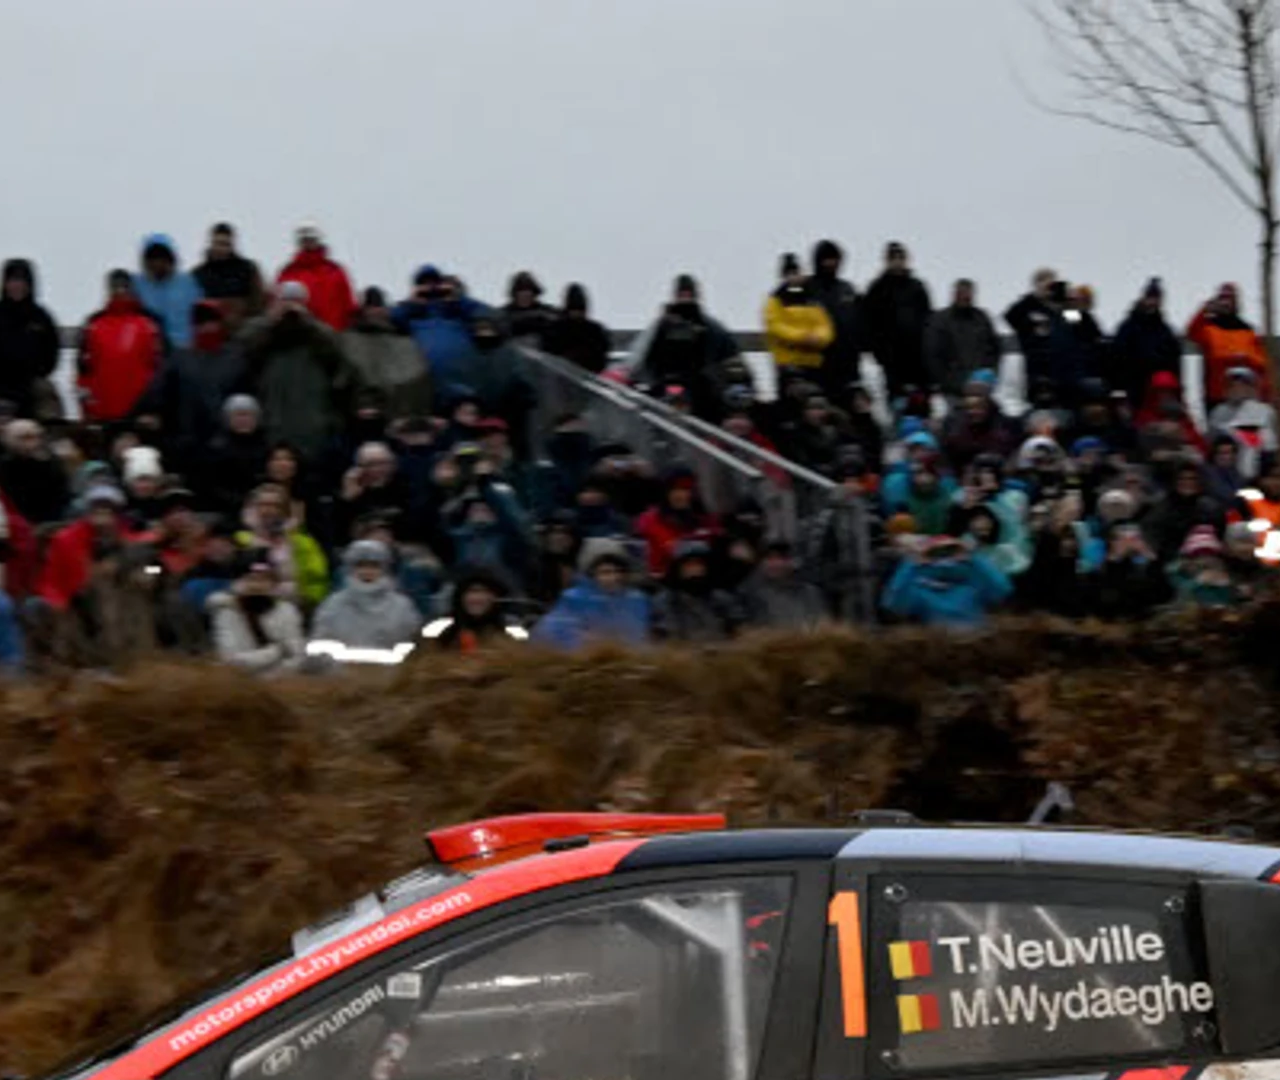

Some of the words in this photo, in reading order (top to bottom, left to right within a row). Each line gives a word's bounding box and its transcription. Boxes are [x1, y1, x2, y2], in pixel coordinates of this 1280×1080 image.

[168, 891, 472, 1051] motorsport.hyundai.com
[827, 890, 867, 1038] 1
[937, 924, 1165, 974] T.Neuville
[300, 983, 386, 1051] HYUNDAI
[950, 974, 1213, 1031] M.Wydaeghe
